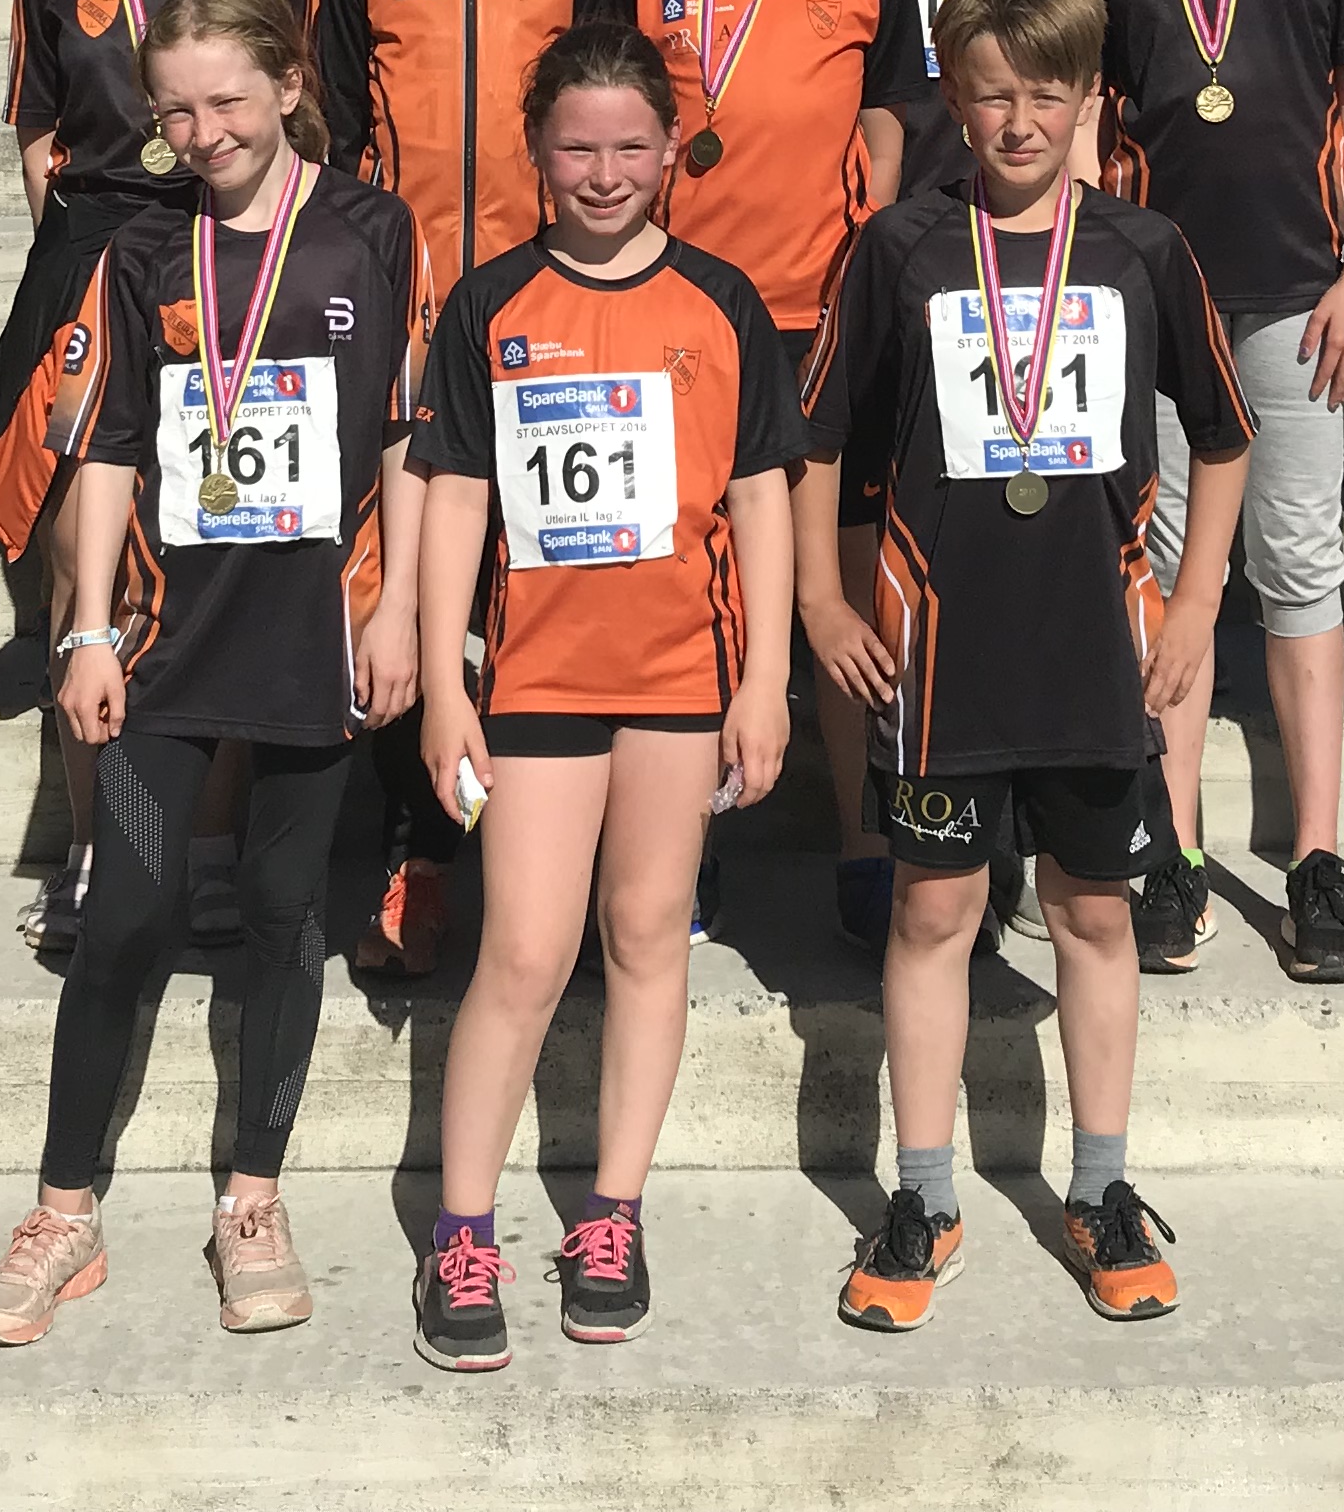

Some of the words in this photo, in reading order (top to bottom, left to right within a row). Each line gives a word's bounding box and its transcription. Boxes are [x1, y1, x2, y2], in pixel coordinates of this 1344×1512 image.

[957, 338, 972, 349] ST
[1073, 334, 1099, 345] 2018
[530, 348, 585, 362] Sparebank
[522, 386, 607, 409] SpareBank
[178, 410, 194, 421] ST
[286, 405, 312, 417] 2018
[516, 428, 529, 439] ST
[531, 423, 616, 437] OLAVSLOPPET
[620, 422, 647, 432] 2018
[1050, 424, 1067, 435] lag
[1070, 423, 1077, 433] 2
[188, 424, 300, 485] 161
[989, 441, 1066, 461] SparBank
[526, 440, 636, 506] 161
[260, 493, 277, 504] lag
[280, 493, 287, 502] 2
[202, 511, 275, 528] SpareBank
[546, 513, 577, 525] Utleira
[579, 512, 590, 522] IL
[596, 511, 613, 522] lag
[616, 510, 623, 519] 2
[543, 530, 612, 550] SpareBank
